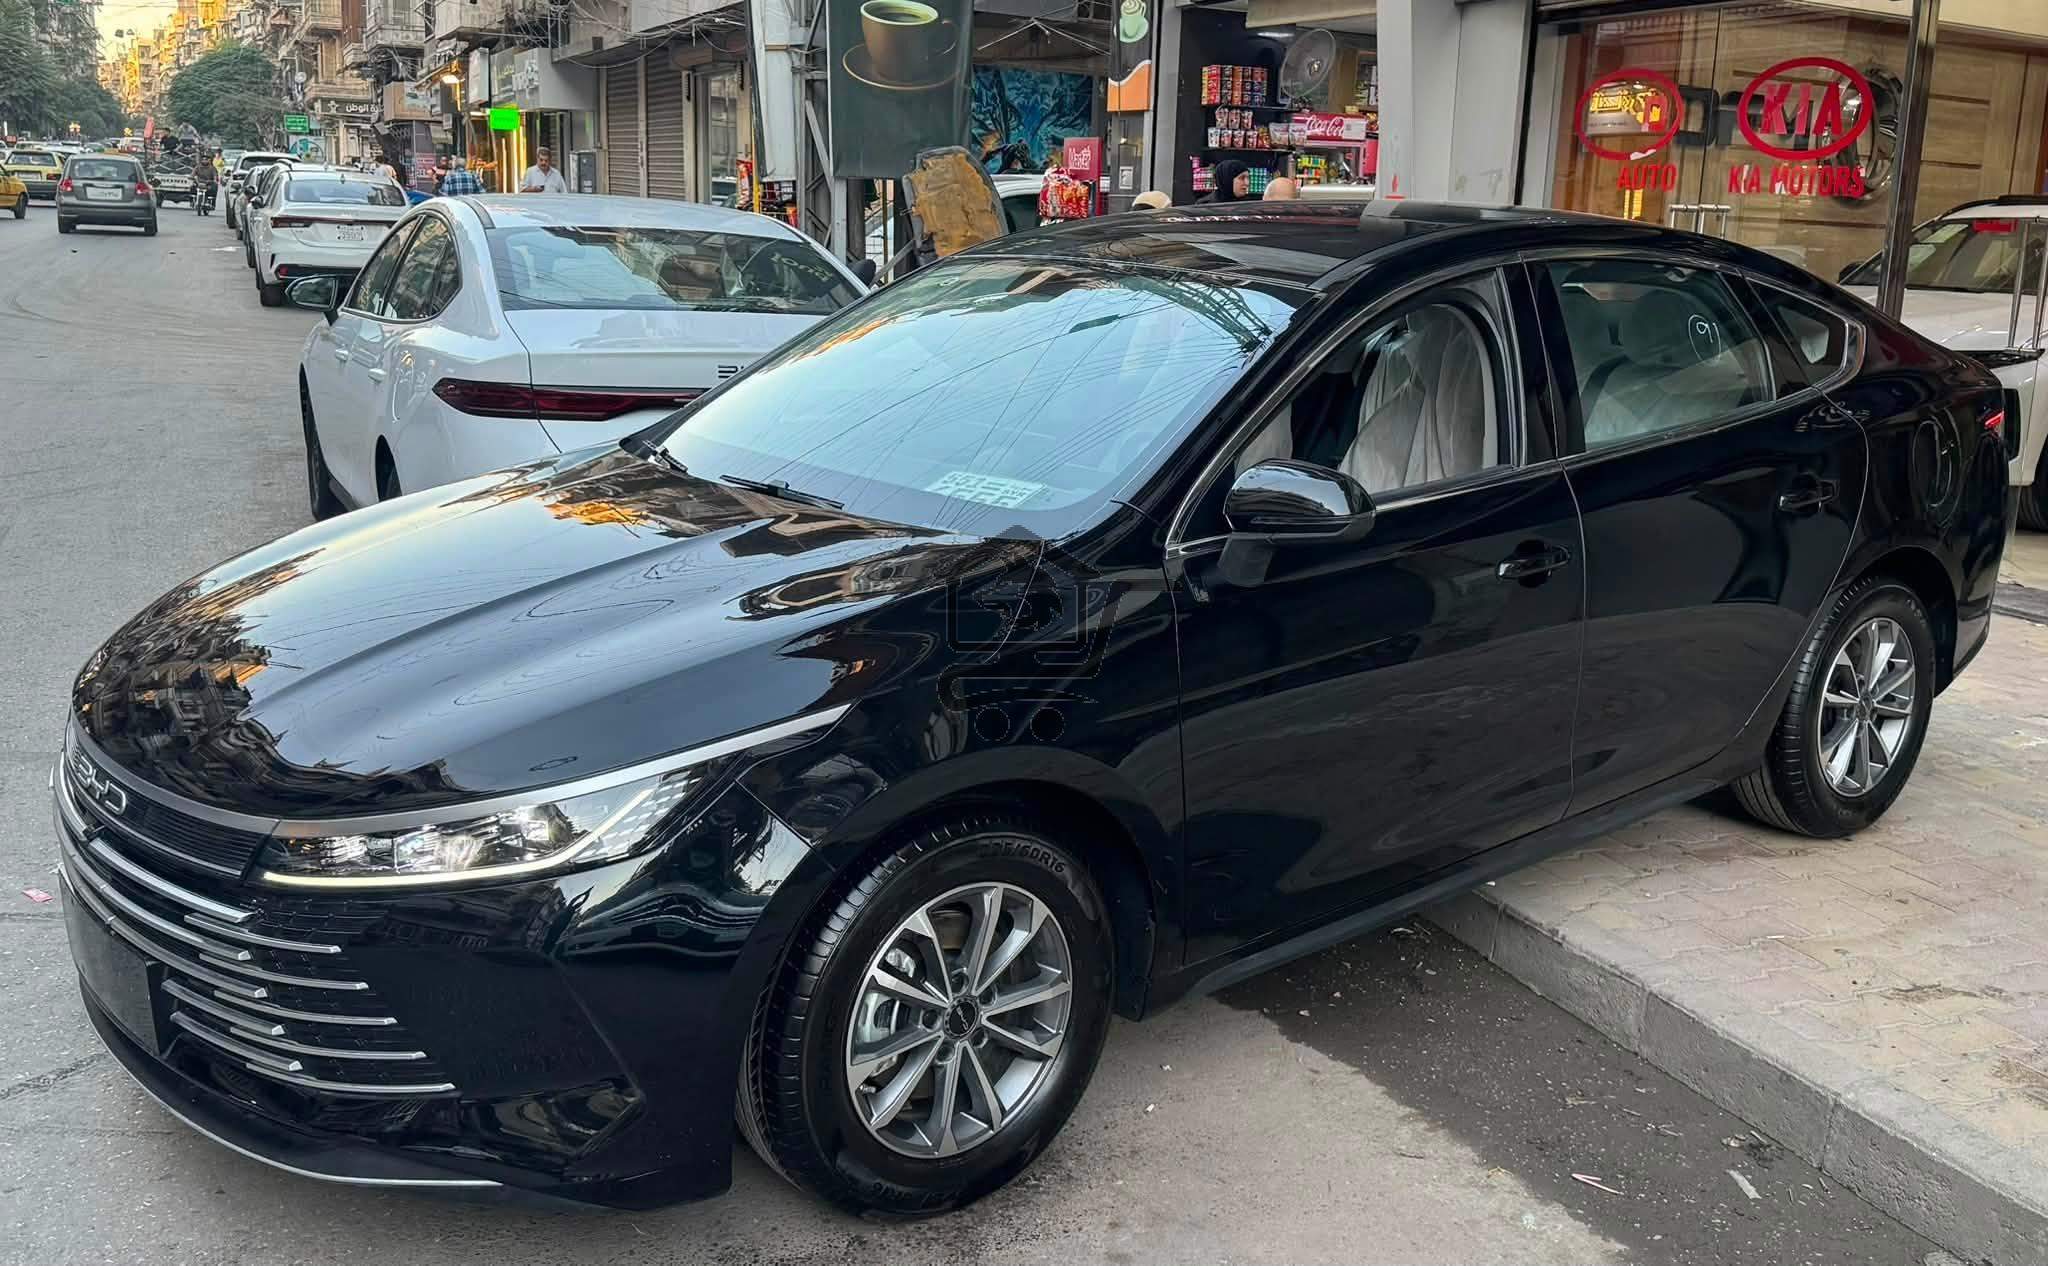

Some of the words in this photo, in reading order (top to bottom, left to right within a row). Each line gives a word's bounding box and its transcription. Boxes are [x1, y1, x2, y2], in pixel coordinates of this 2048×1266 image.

[1758, 81, 1844, 136] KIA
[1616, 163, 1678, 193] AUTO
[1769, 164, 1866, 198] MOTORS
[76, 755, 127, 816] BYD
